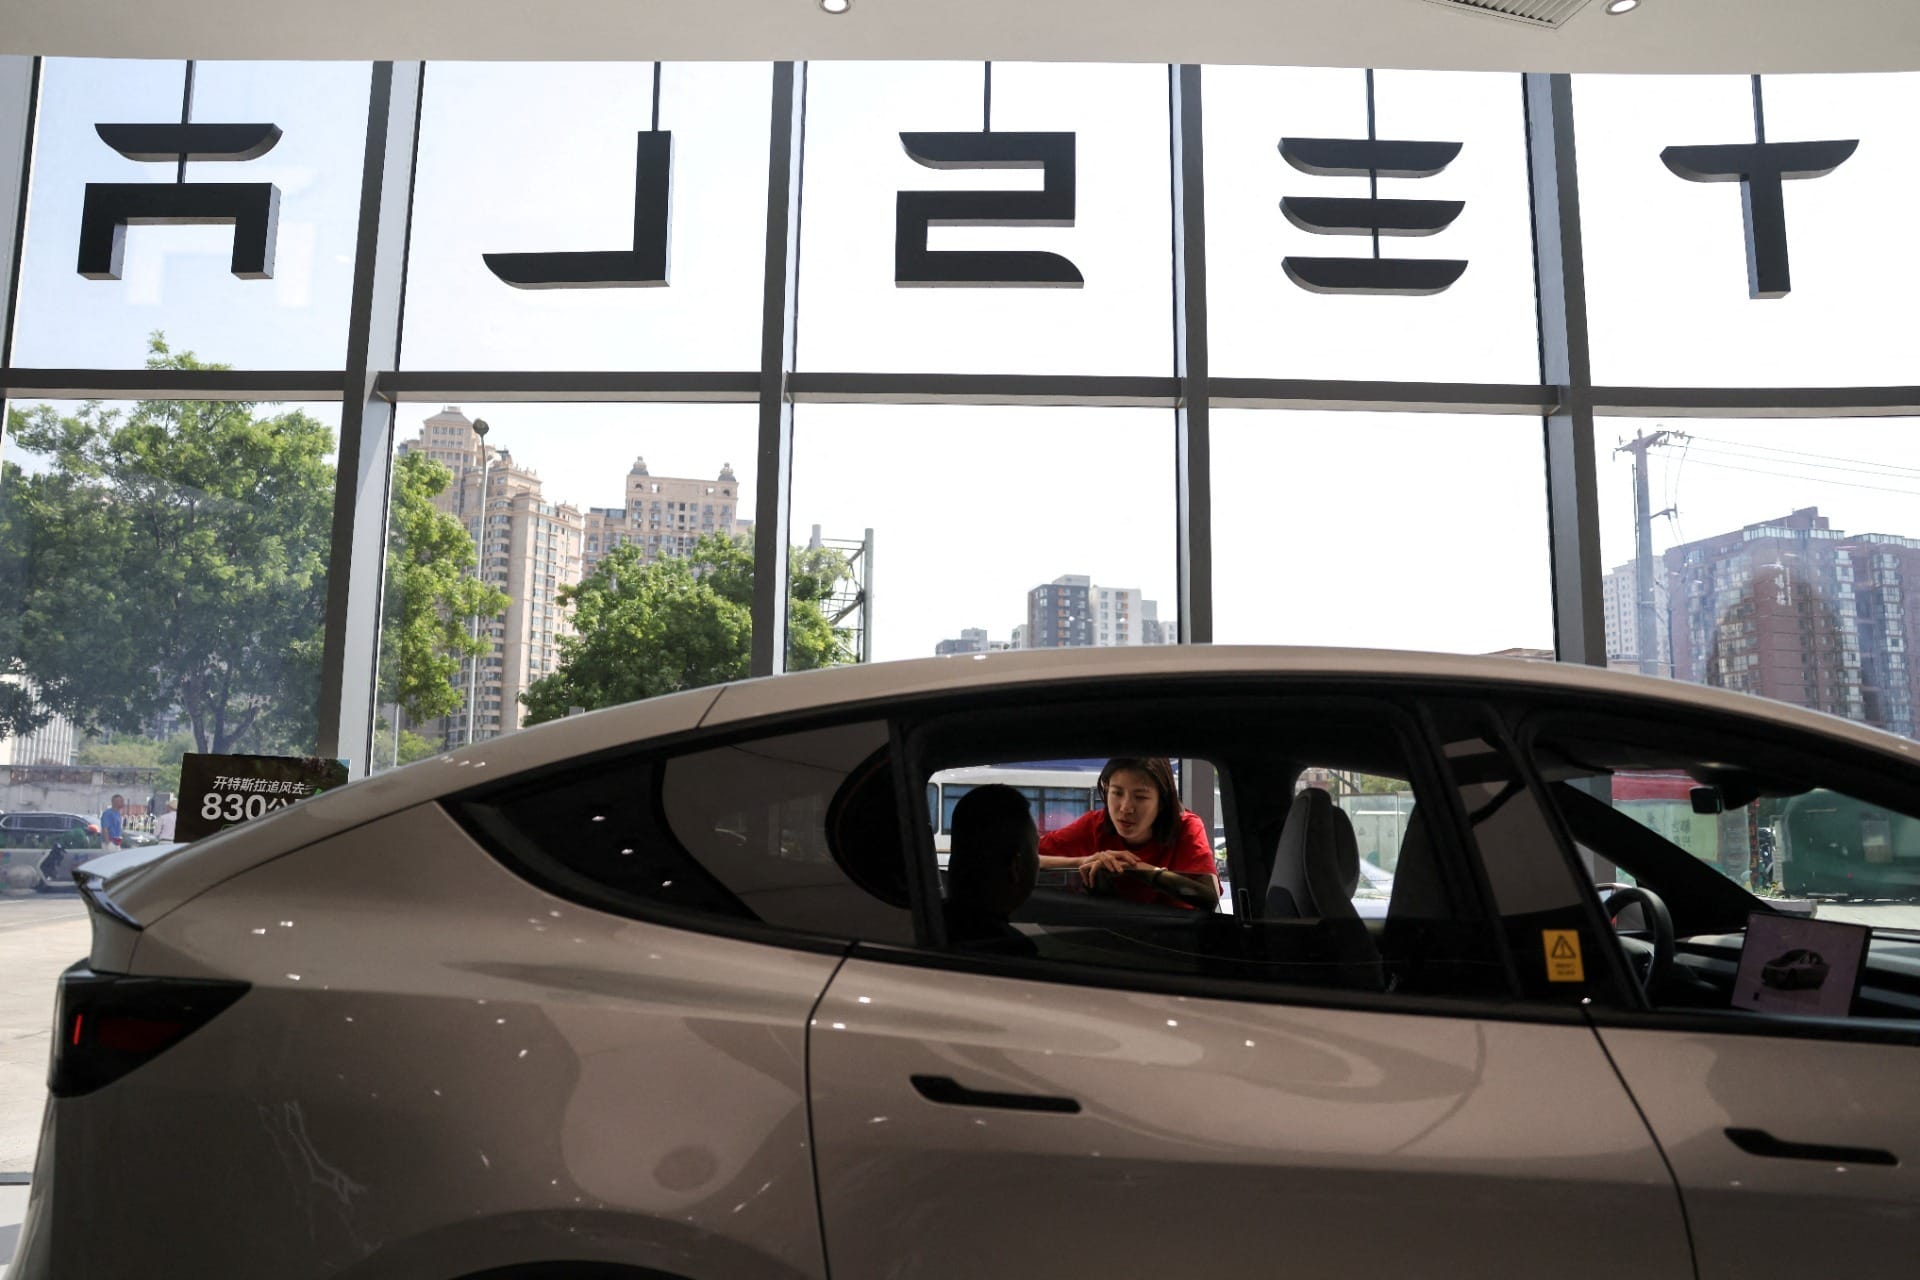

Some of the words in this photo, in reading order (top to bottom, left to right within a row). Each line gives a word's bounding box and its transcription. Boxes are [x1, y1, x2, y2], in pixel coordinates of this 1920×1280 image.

[212, 776, 305, 795] 开特斯拉追风去
